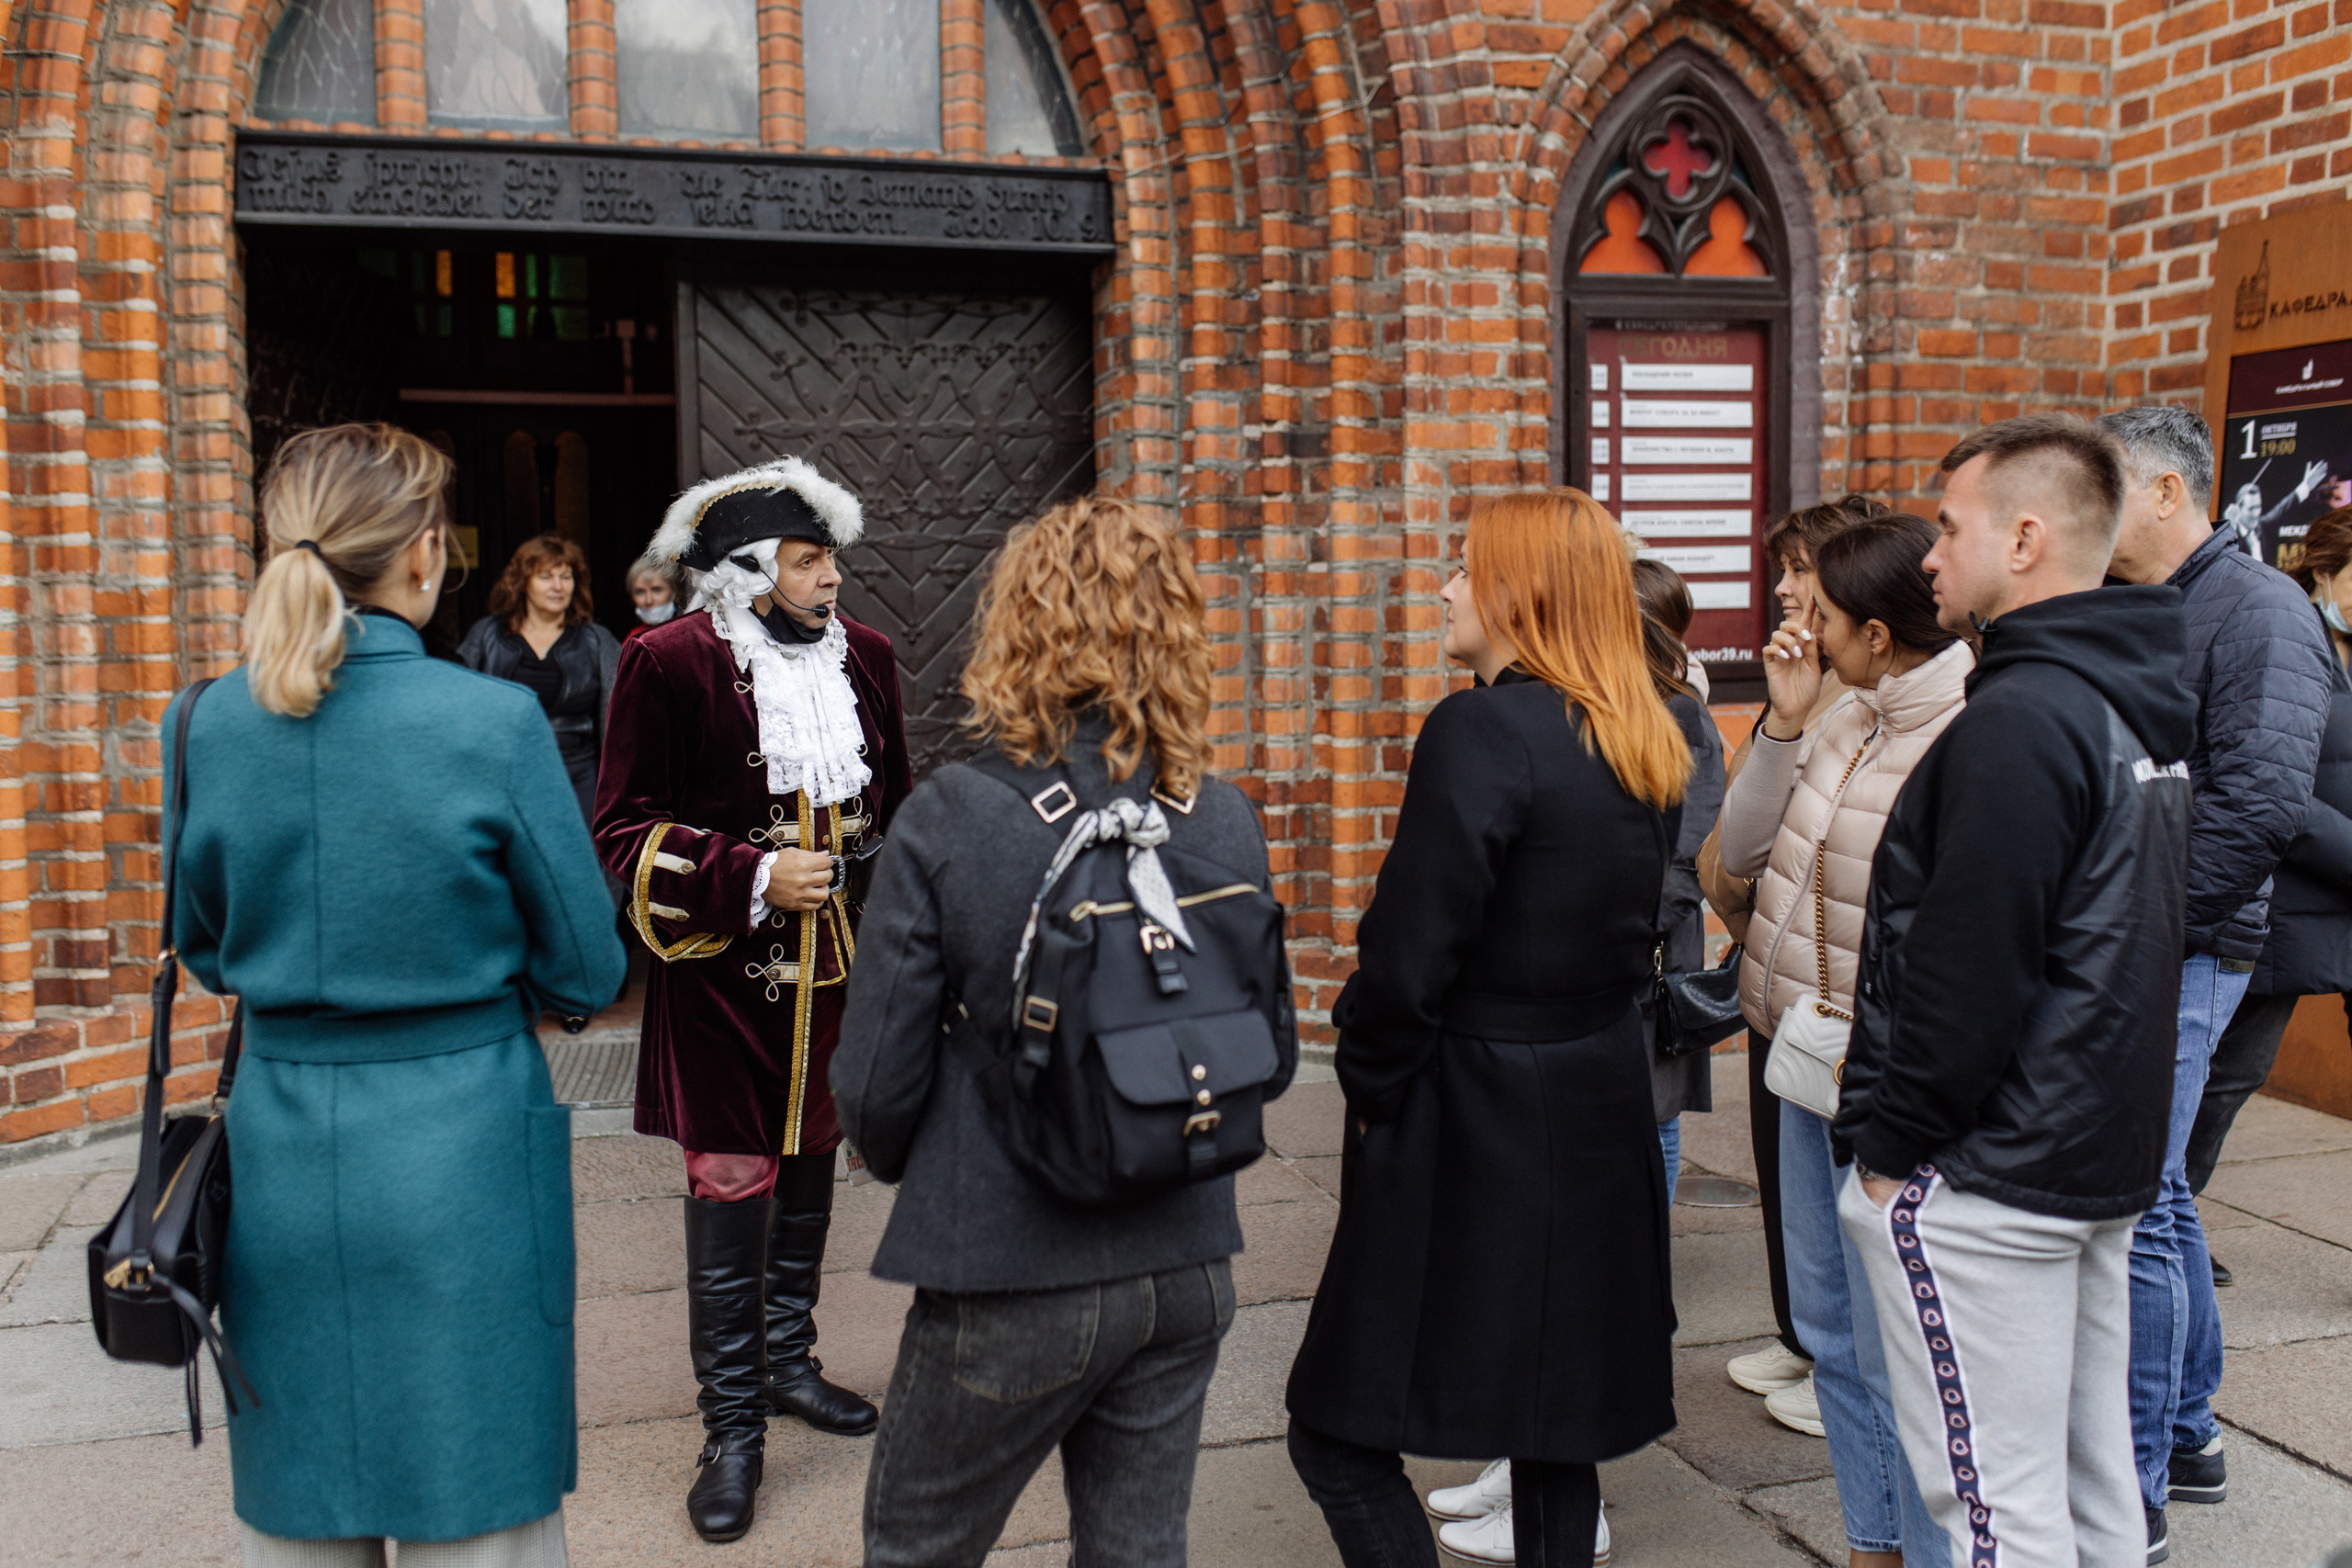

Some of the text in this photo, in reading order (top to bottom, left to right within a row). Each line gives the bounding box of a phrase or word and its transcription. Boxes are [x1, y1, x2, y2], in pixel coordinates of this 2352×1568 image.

[1617, 335, 1728, 359] СЕГОДНЯ
[2239, 418, 2258, 460] 1
[2259, 437, 2297, 458] 19:00
